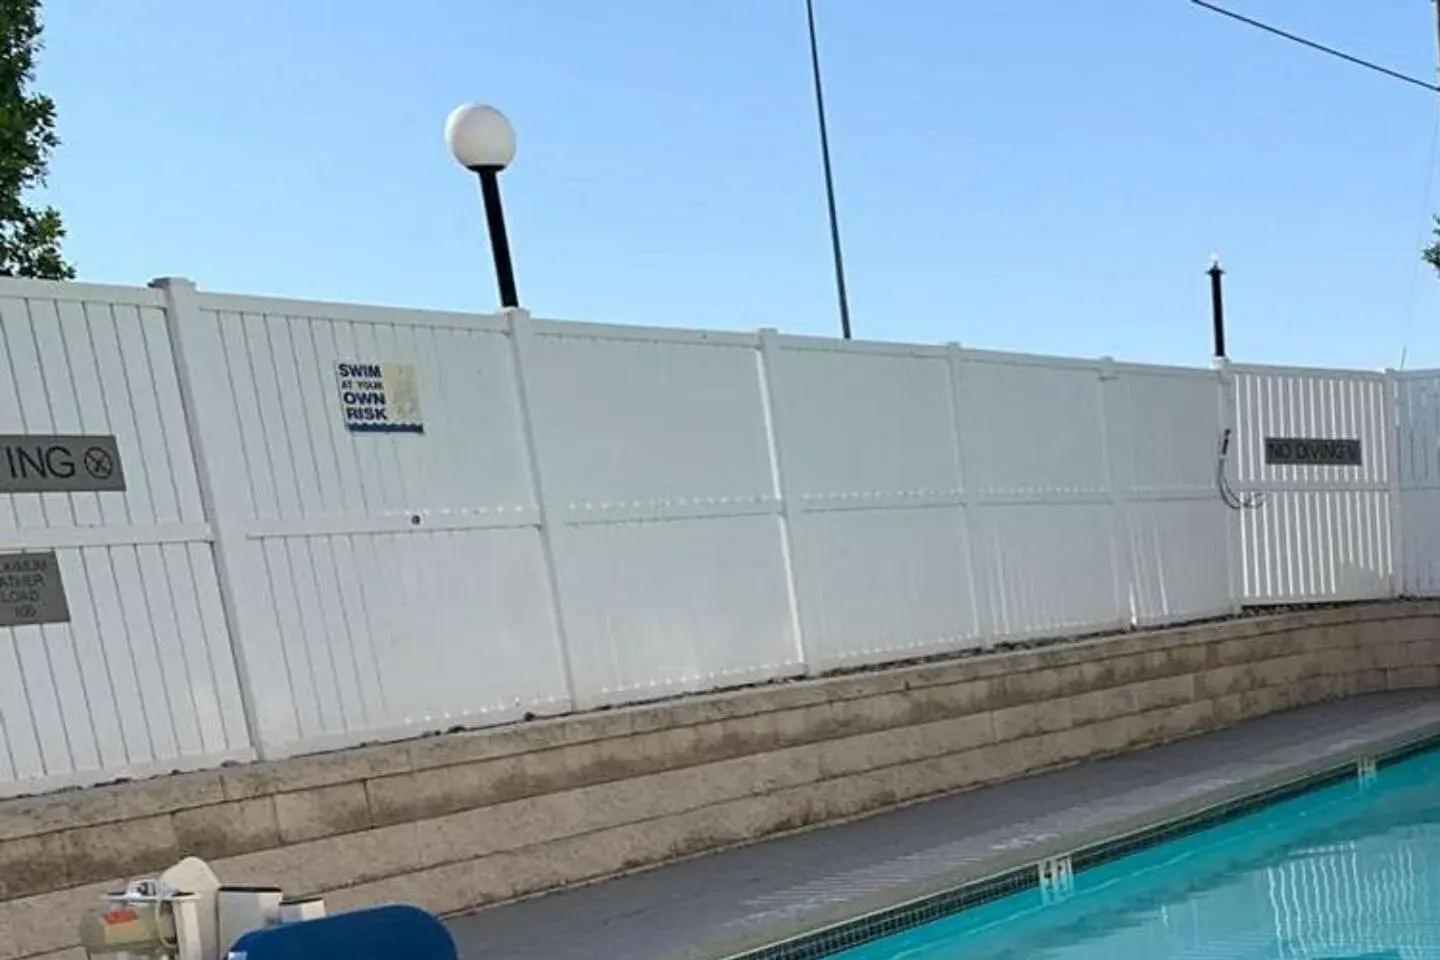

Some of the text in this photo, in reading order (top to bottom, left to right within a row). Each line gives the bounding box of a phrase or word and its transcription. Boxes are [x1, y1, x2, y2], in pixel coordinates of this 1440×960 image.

[339, 363, 382, 378] SWIM
[344, 392, 386, 405] OWN
[347, 407, 388, 421] RISK
[1296, 443, 1345, 460] DIVING
[6, 445, 76, 479] ING
